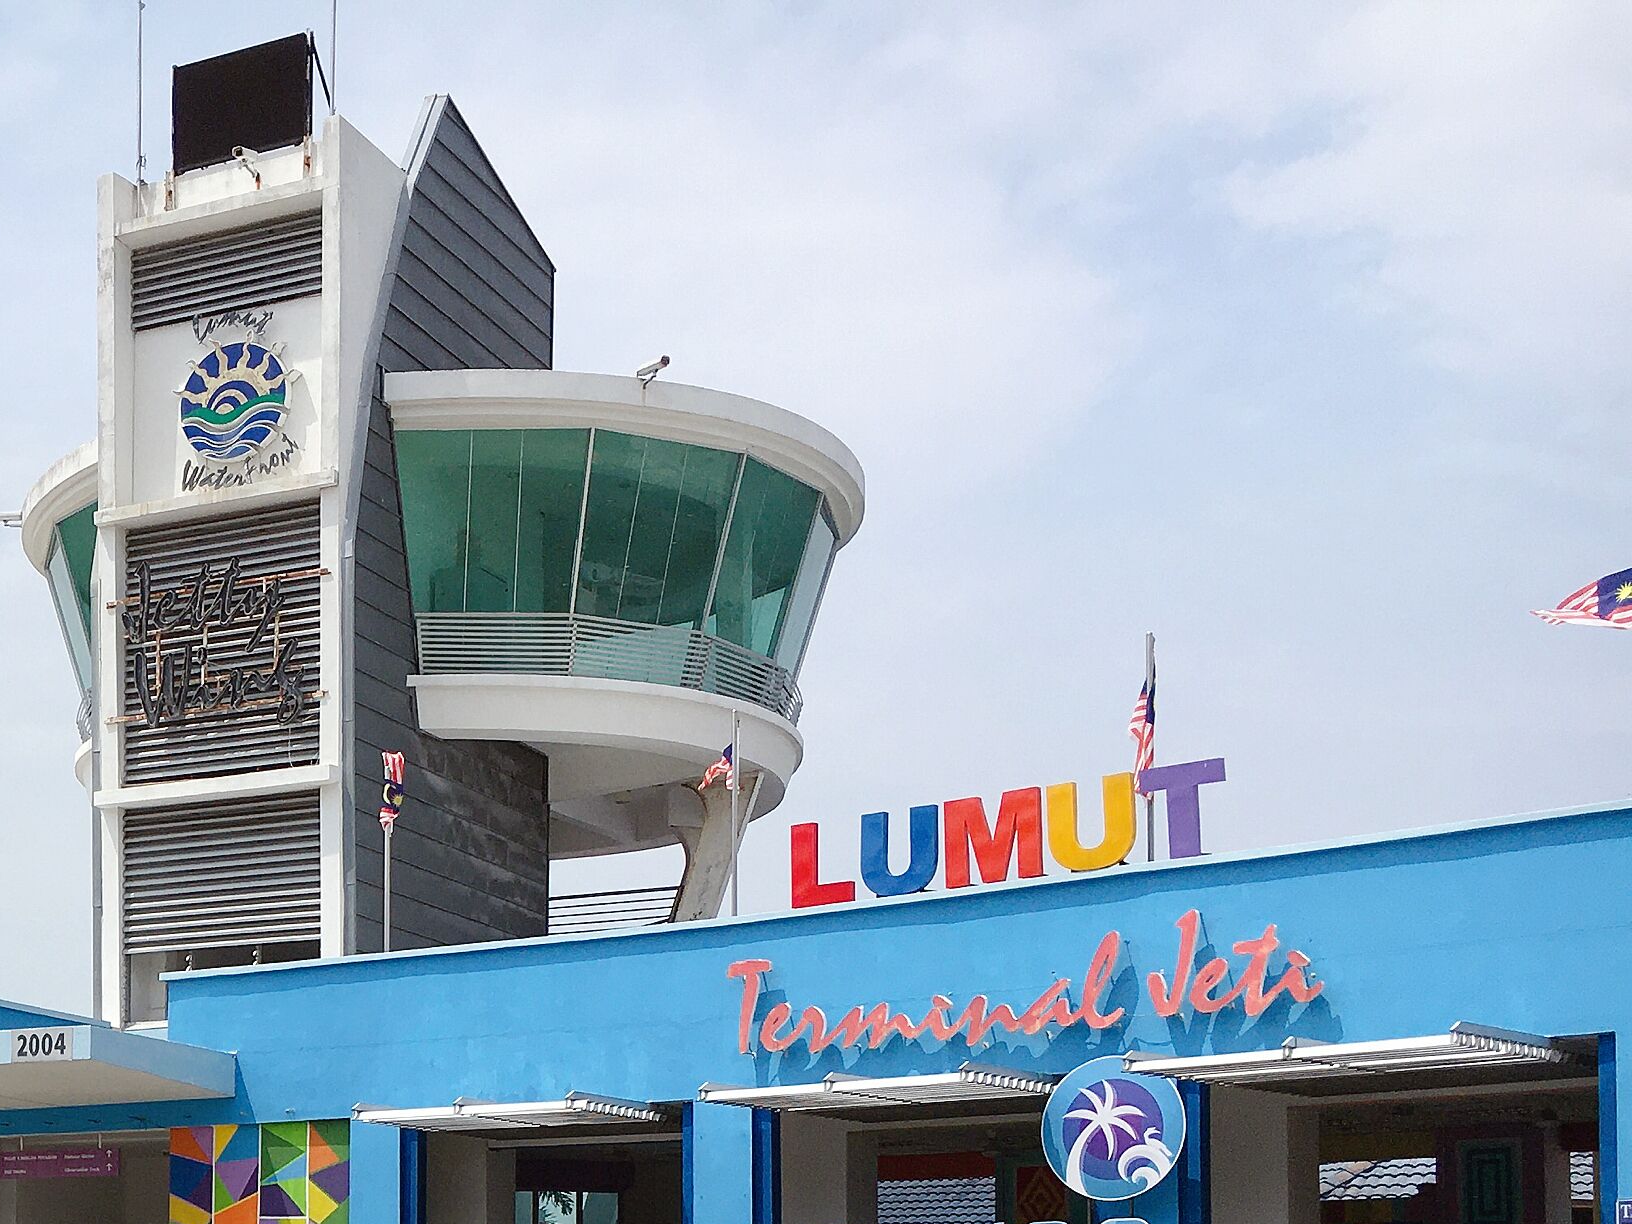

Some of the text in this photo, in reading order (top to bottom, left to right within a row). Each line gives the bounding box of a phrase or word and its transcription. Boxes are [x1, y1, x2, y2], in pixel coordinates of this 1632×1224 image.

[122, 556, 286, 652] Jetty
[789, 757, 1226, 910] LUMUT
[727, 908, 1326, 1056] Terminal Jeti
[17, 1033, 66, 1057] 2004
[1620, 1204, 1632, 1219] T
